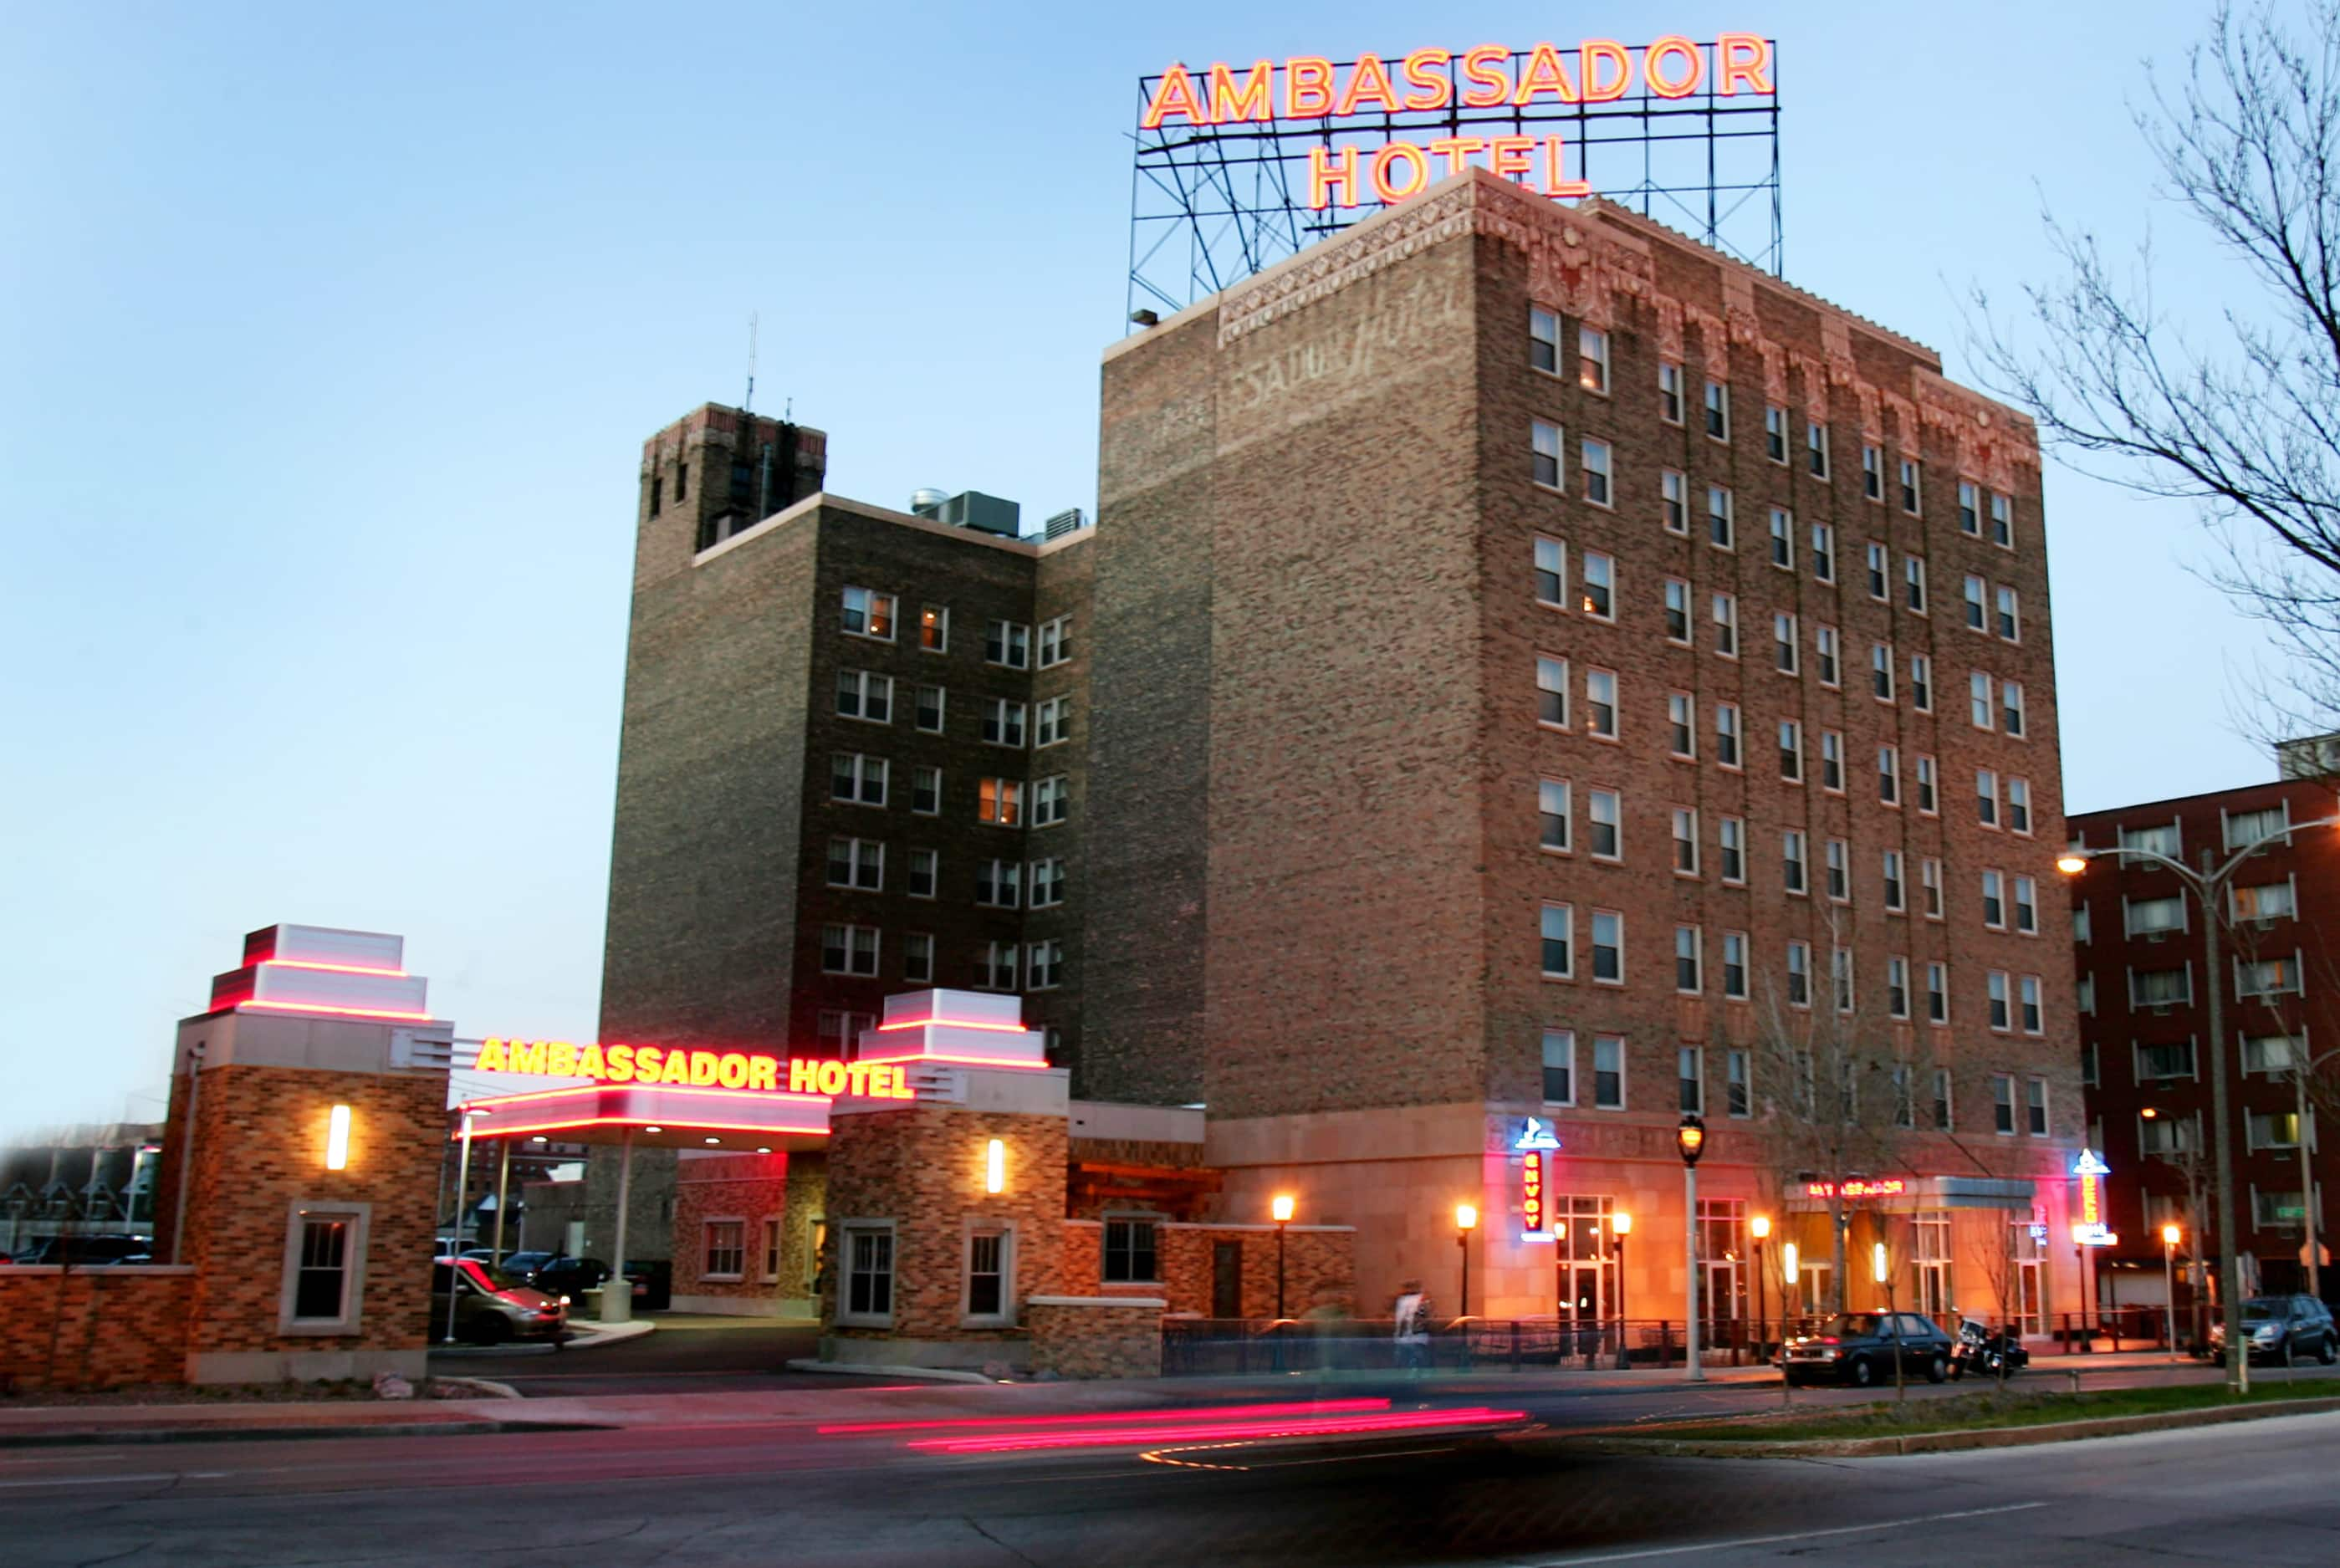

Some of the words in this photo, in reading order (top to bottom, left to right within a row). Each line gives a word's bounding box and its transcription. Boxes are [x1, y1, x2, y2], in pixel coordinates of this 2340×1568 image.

[1142, 33, 1775, 129] AMBASSADOR
[1309, 134, 1591, 210] HOTEL
[474, 1038, 778, 1091] AMBASSADOR
[789, 1057, 917, 1100] HOTEL
[1524, 1153, 1540, 1228] ENVOY
